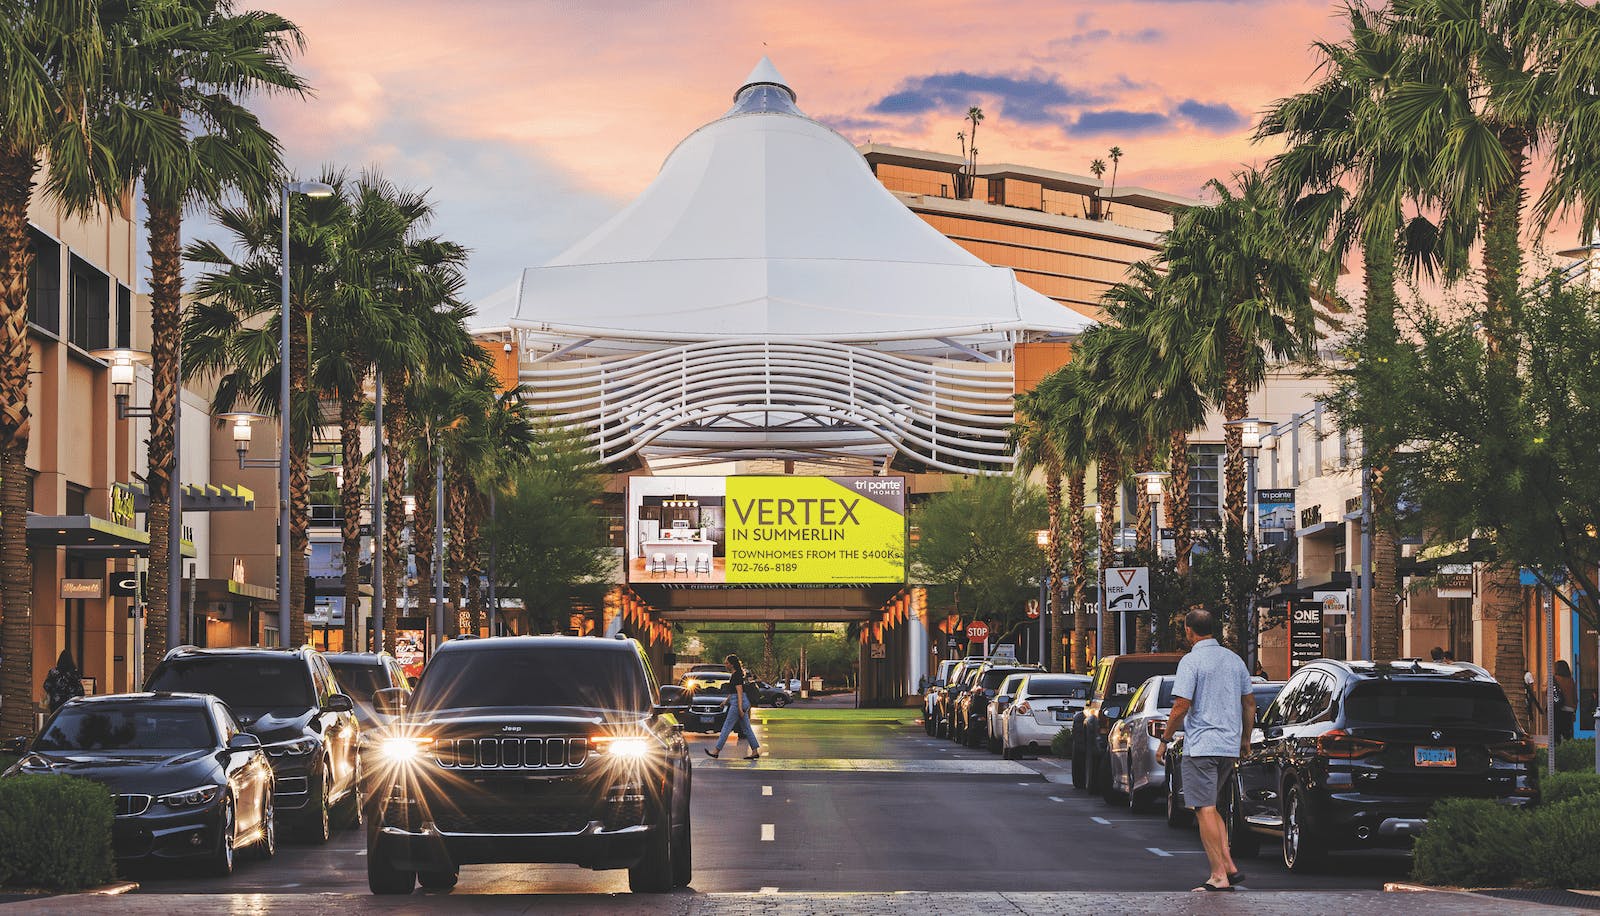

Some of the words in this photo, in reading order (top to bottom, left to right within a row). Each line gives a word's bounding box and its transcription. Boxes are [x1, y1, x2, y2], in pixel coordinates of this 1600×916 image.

[854, 480, 867, 490] tri
[868, 480, 900, 492] pointe
[732, 498, 860, 526] VERTEX
[732, 528, 748, 541] IN
[753, 528, 845, 541] SUMMERLIN
[732, 550, 803, 559] TOWNHOMES
[806, 550, 836, 559] FROM
[839, 550, 859, 559] THE
[731, 563, 798, 572] 702-766-8189
[1294, 610, 1319, 620] ONE
[968, 627, 988, 637] STOP
